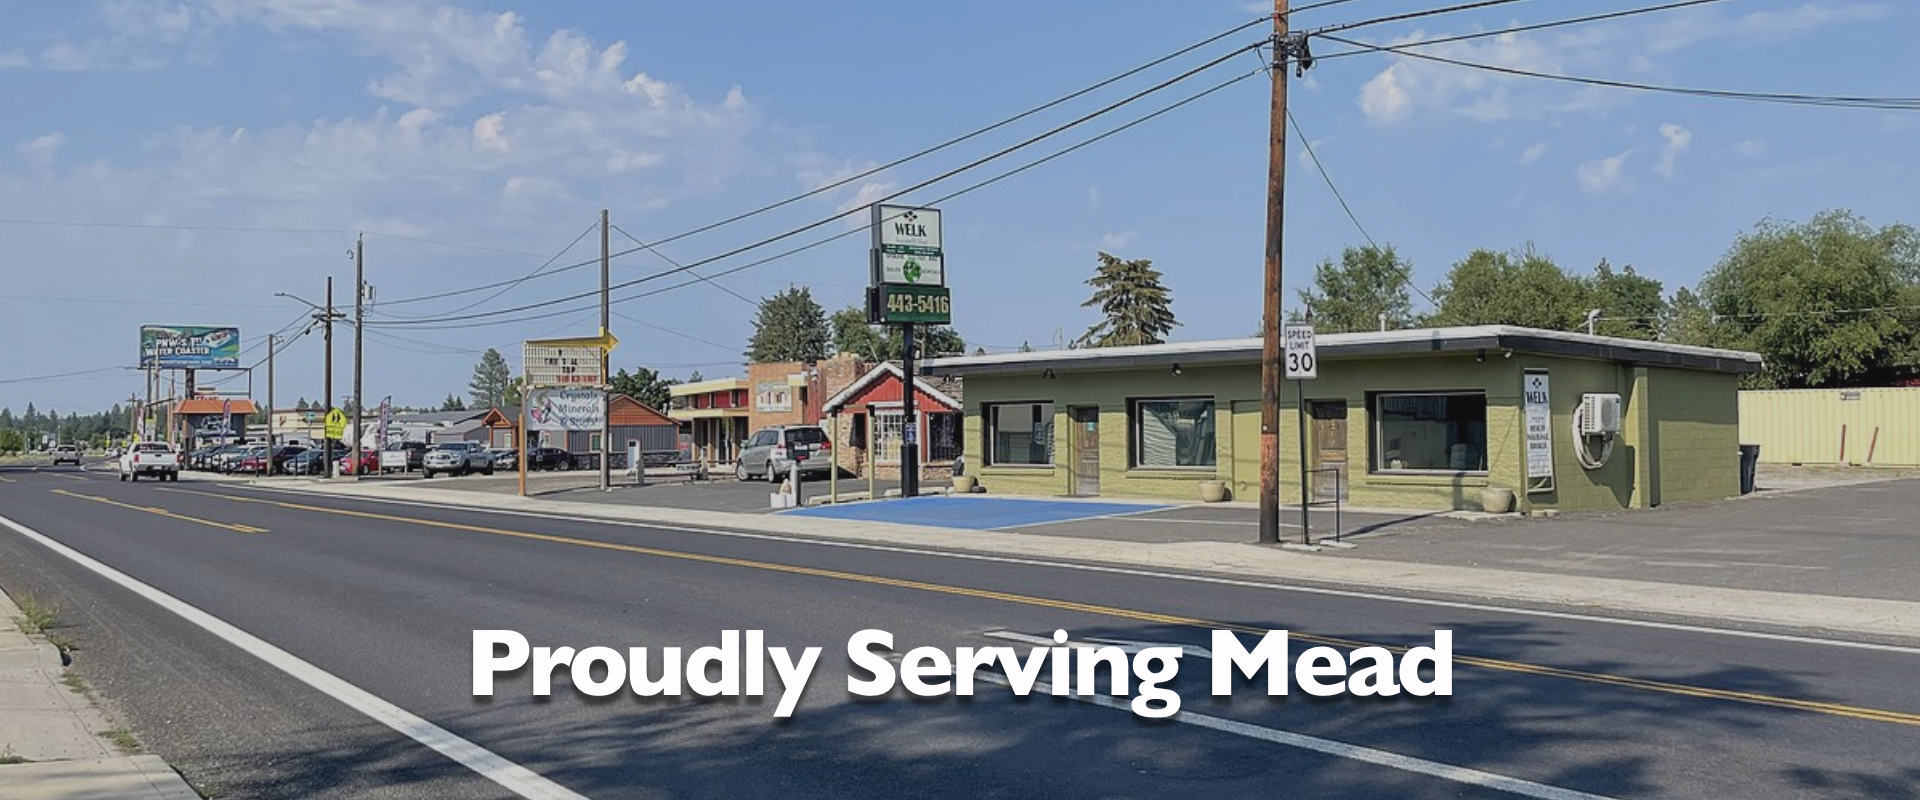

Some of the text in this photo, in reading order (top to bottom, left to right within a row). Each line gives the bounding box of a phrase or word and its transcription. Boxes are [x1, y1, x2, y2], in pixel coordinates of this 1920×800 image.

[895, 222, 927, 237] WELK
[887, 294, 950, 314] 443-5416
[1288, 330, 1311, 340] SPEED
[1290, 341, 1309, 350] LIMIT
[175, 347, 210, 356] COASTER
[1289, 353, 1313, 372] 30
[560, 391, 598, 402] Crystals
[1526, 391, 1549, 404] WELK
[558, 403, 599, 413] Minerals
